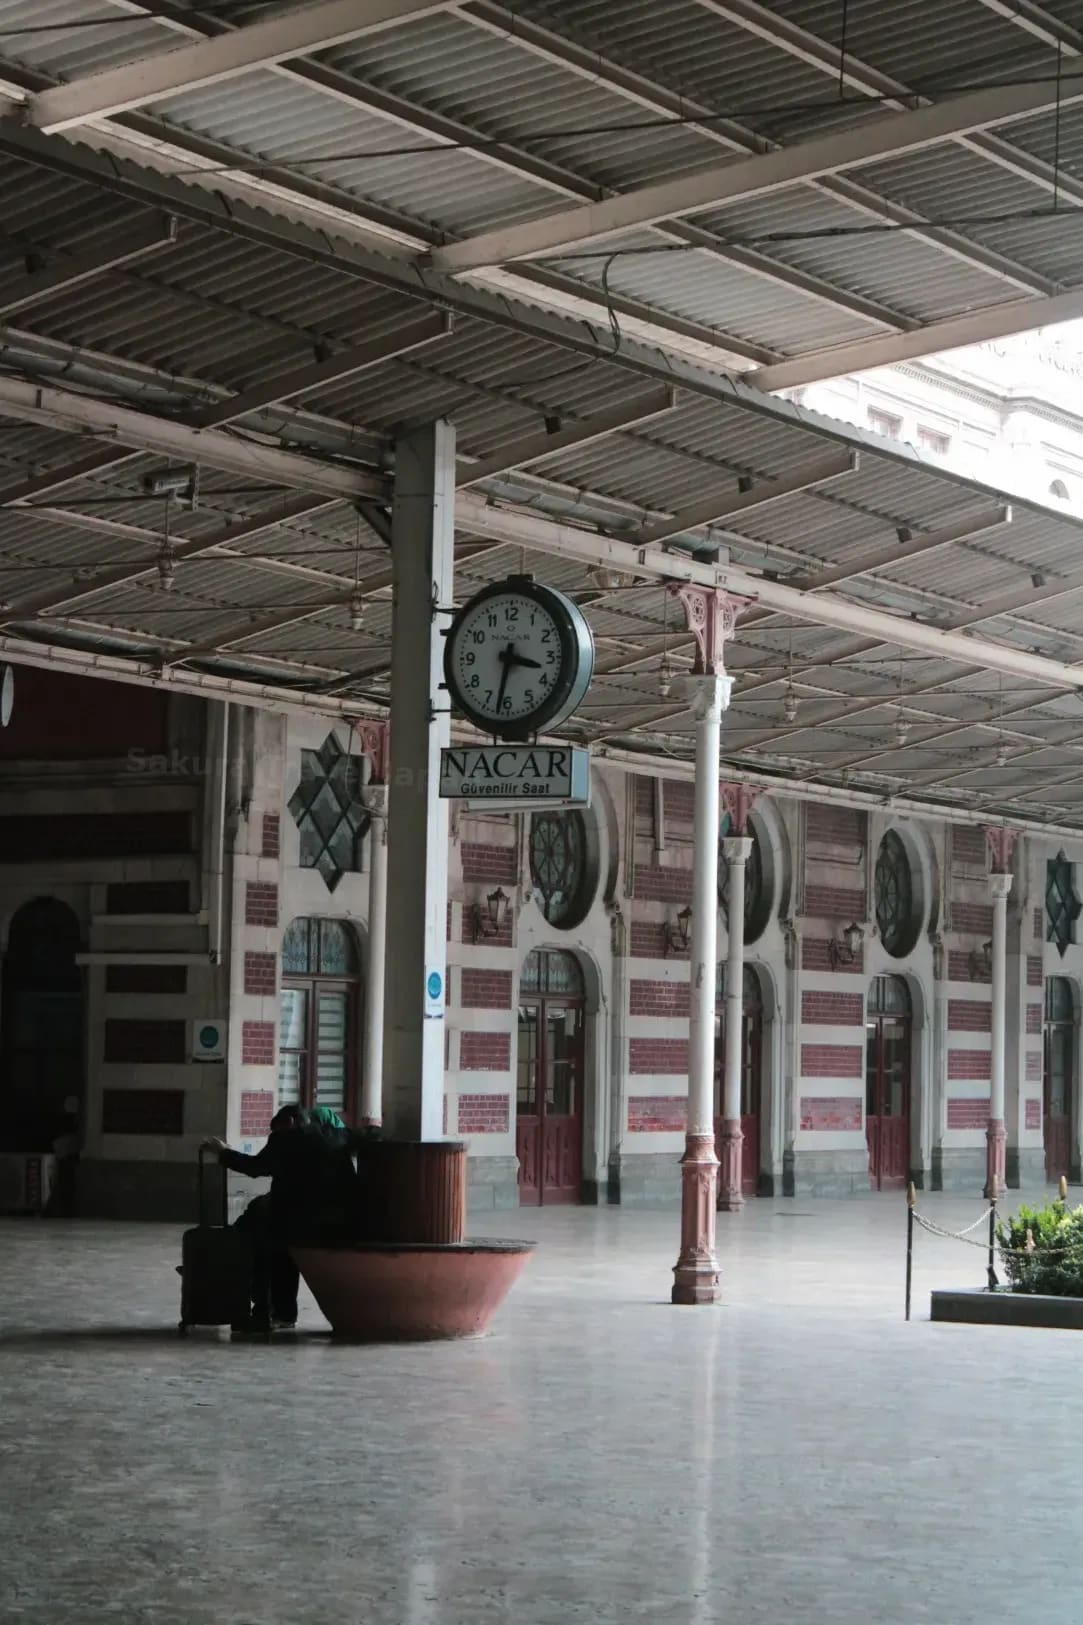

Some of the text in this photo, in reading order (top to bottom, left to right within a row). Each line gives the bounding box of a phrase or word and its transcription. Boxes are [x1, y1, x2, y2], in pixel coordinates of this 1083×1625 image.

[487, 613, 498, 628] 11
[505, 607, 519, 621] 12
[530, 613, 535, 626] 1
[472, 630, 486, 645] 10
[541, 629, 552, 643] 2
[465, 651, 476, 666] 9
[545, 650, 556, 664] 3
[470, 674, 480, 688] 8
[538, 672, 548, 687] 4
[484, 689, 493, 703] 7
[502, 696, 513, 710] 6
[524, 689, 534, 704] 5
[442, 751, 568, 778] NACAR
[460, 782, 550, 794] Güvenilir Saat
